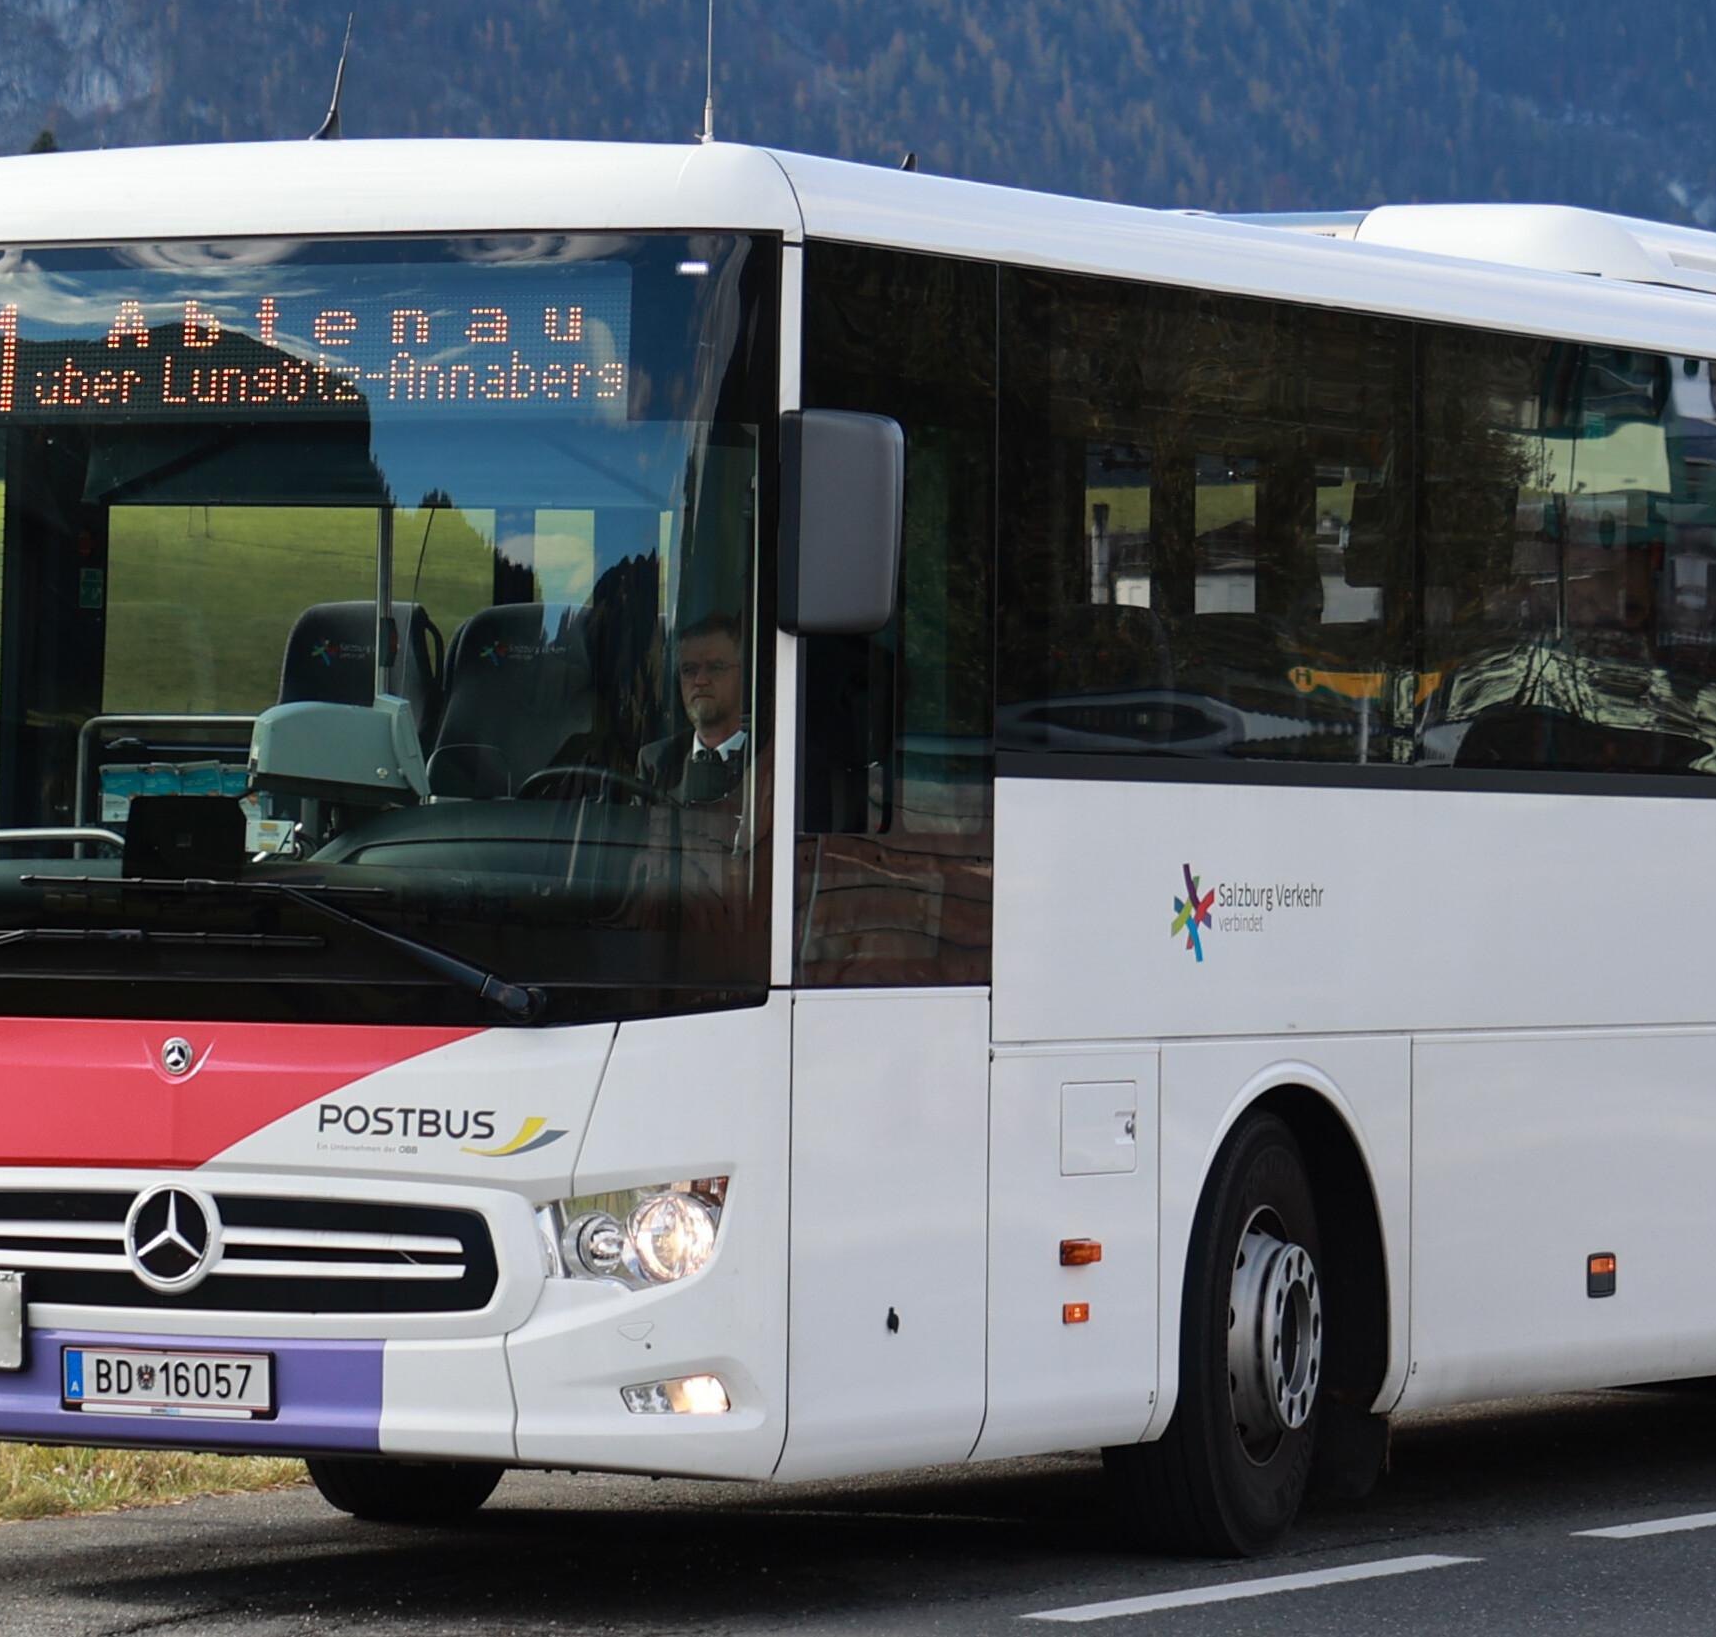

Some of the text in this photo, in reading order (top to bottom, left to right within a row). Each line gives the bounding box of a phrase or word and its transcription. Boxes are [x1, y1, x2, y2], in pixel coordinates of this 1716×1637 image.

[107, 298, 583, 349] Abtenau
[35, 356, 141, 405] über
[1218, 883, 1324, 912] Salzburg Verkehr
[1219, 913, 1264, 933] verbindet
[318, 1104, 497, 1140] POSTBUS
[70, 1359, 253, 1400] A BD 16057
